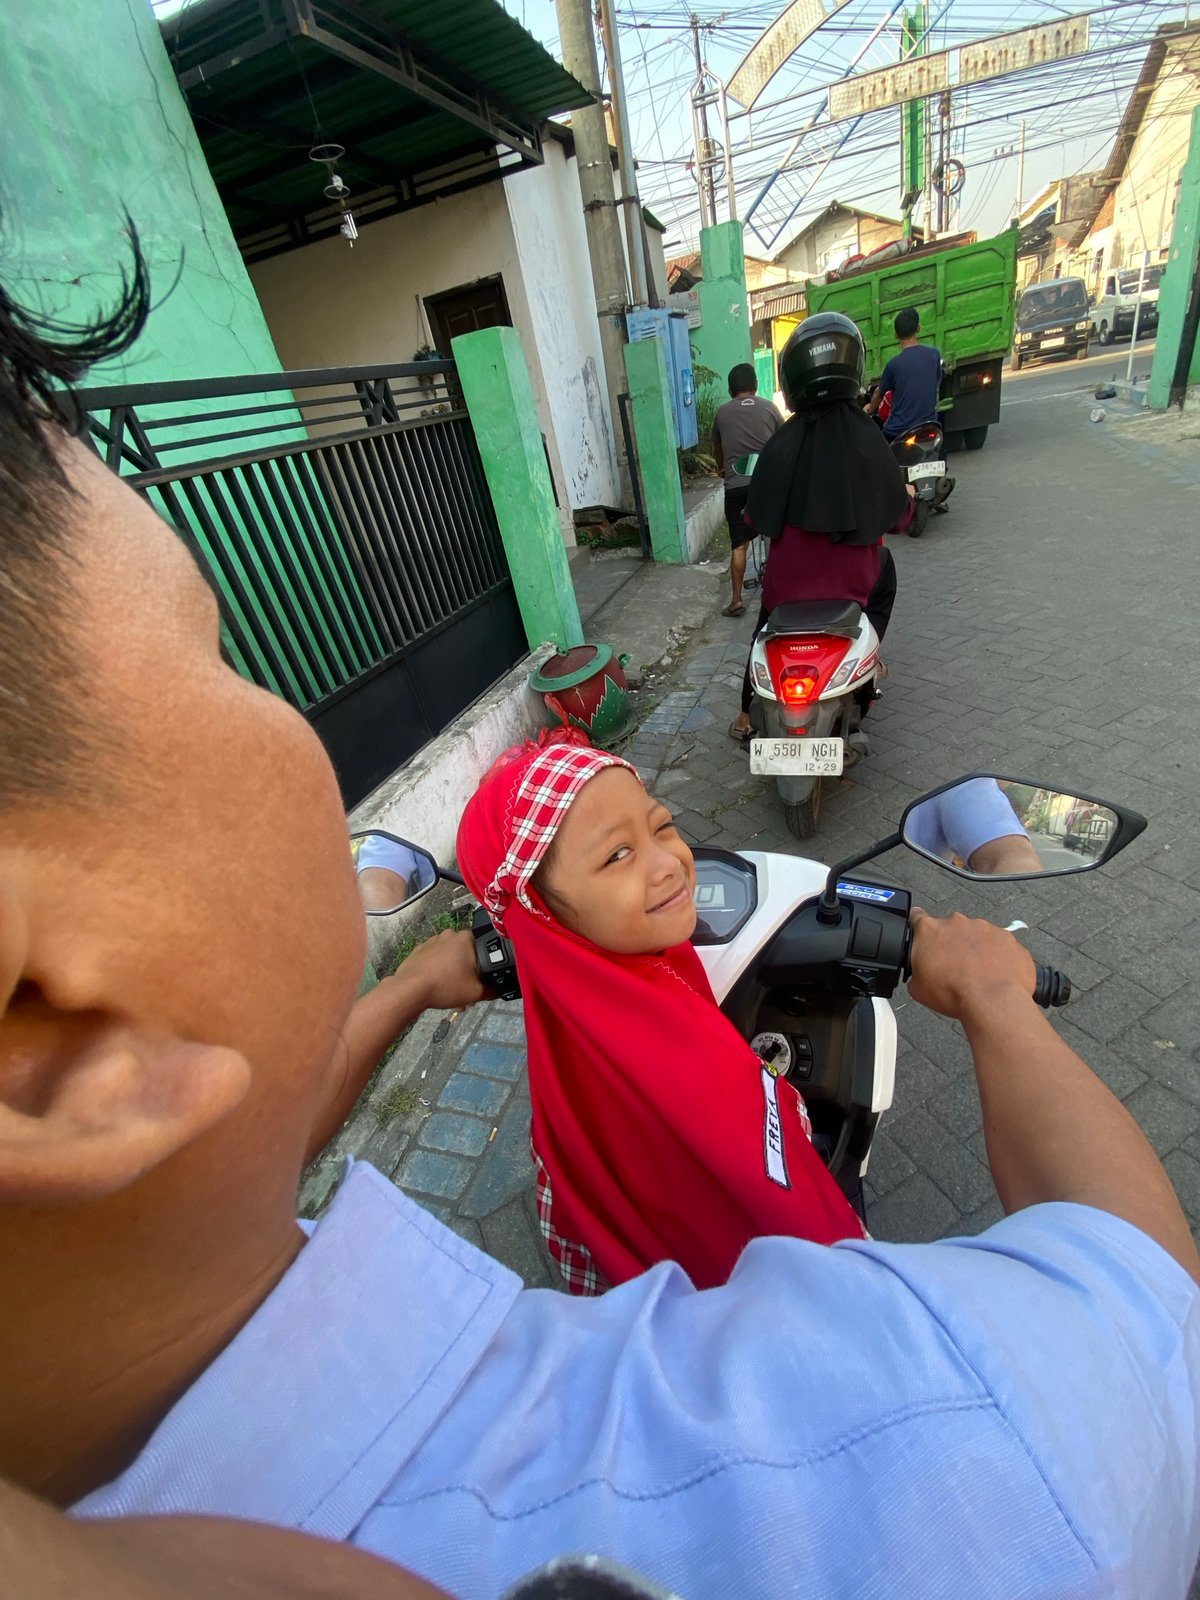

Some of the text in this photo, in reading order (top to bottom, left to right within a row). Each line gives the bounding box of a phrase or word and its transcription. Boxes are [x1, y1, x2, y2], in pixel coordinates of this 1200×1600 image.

[809, 341, 837, 357] YAMAHA
[754, 743, 837, 758] W 5581 NGH
[767, 1097, 781, 1155] FREYA
